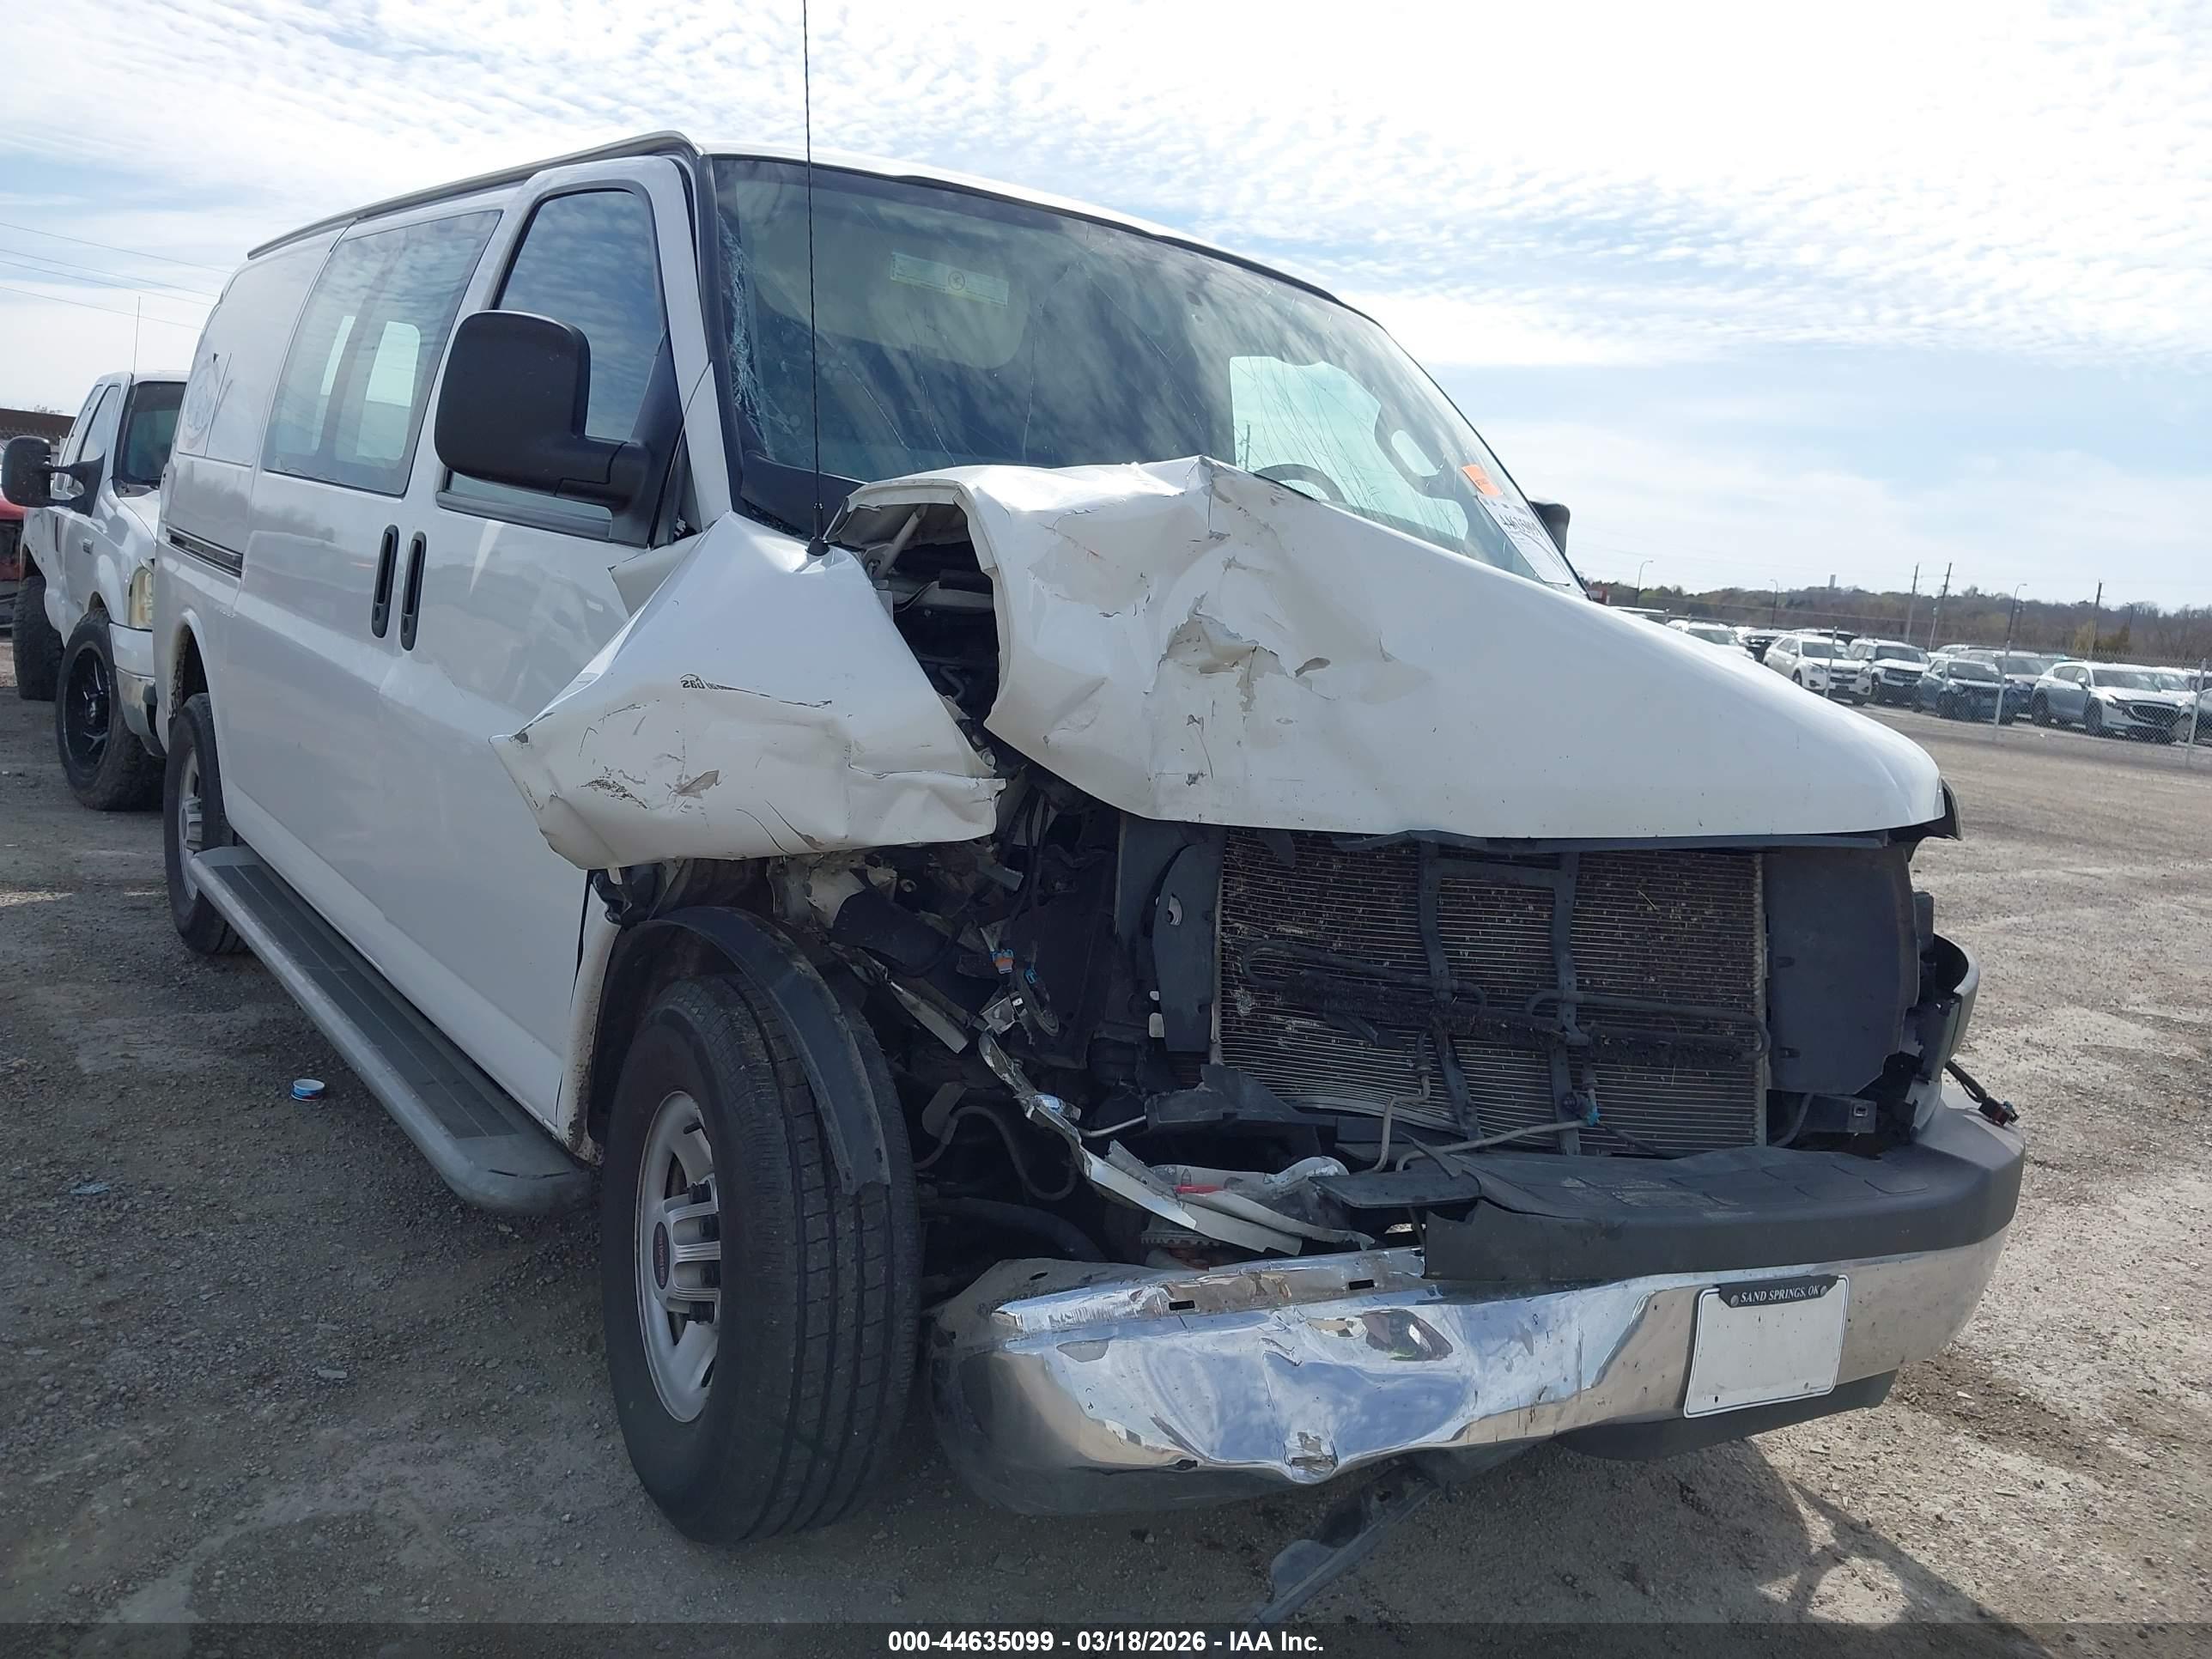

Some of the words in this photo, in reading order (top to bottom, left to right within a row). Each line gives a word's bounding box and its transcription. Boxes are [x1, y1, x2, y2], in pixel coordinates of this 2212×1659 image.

[1741, 1291, 1766, 1303] SAND
[1769, 1288, 1806, 1300] SPRINGS,
[1808, 1285, 1820, 1296] OK
